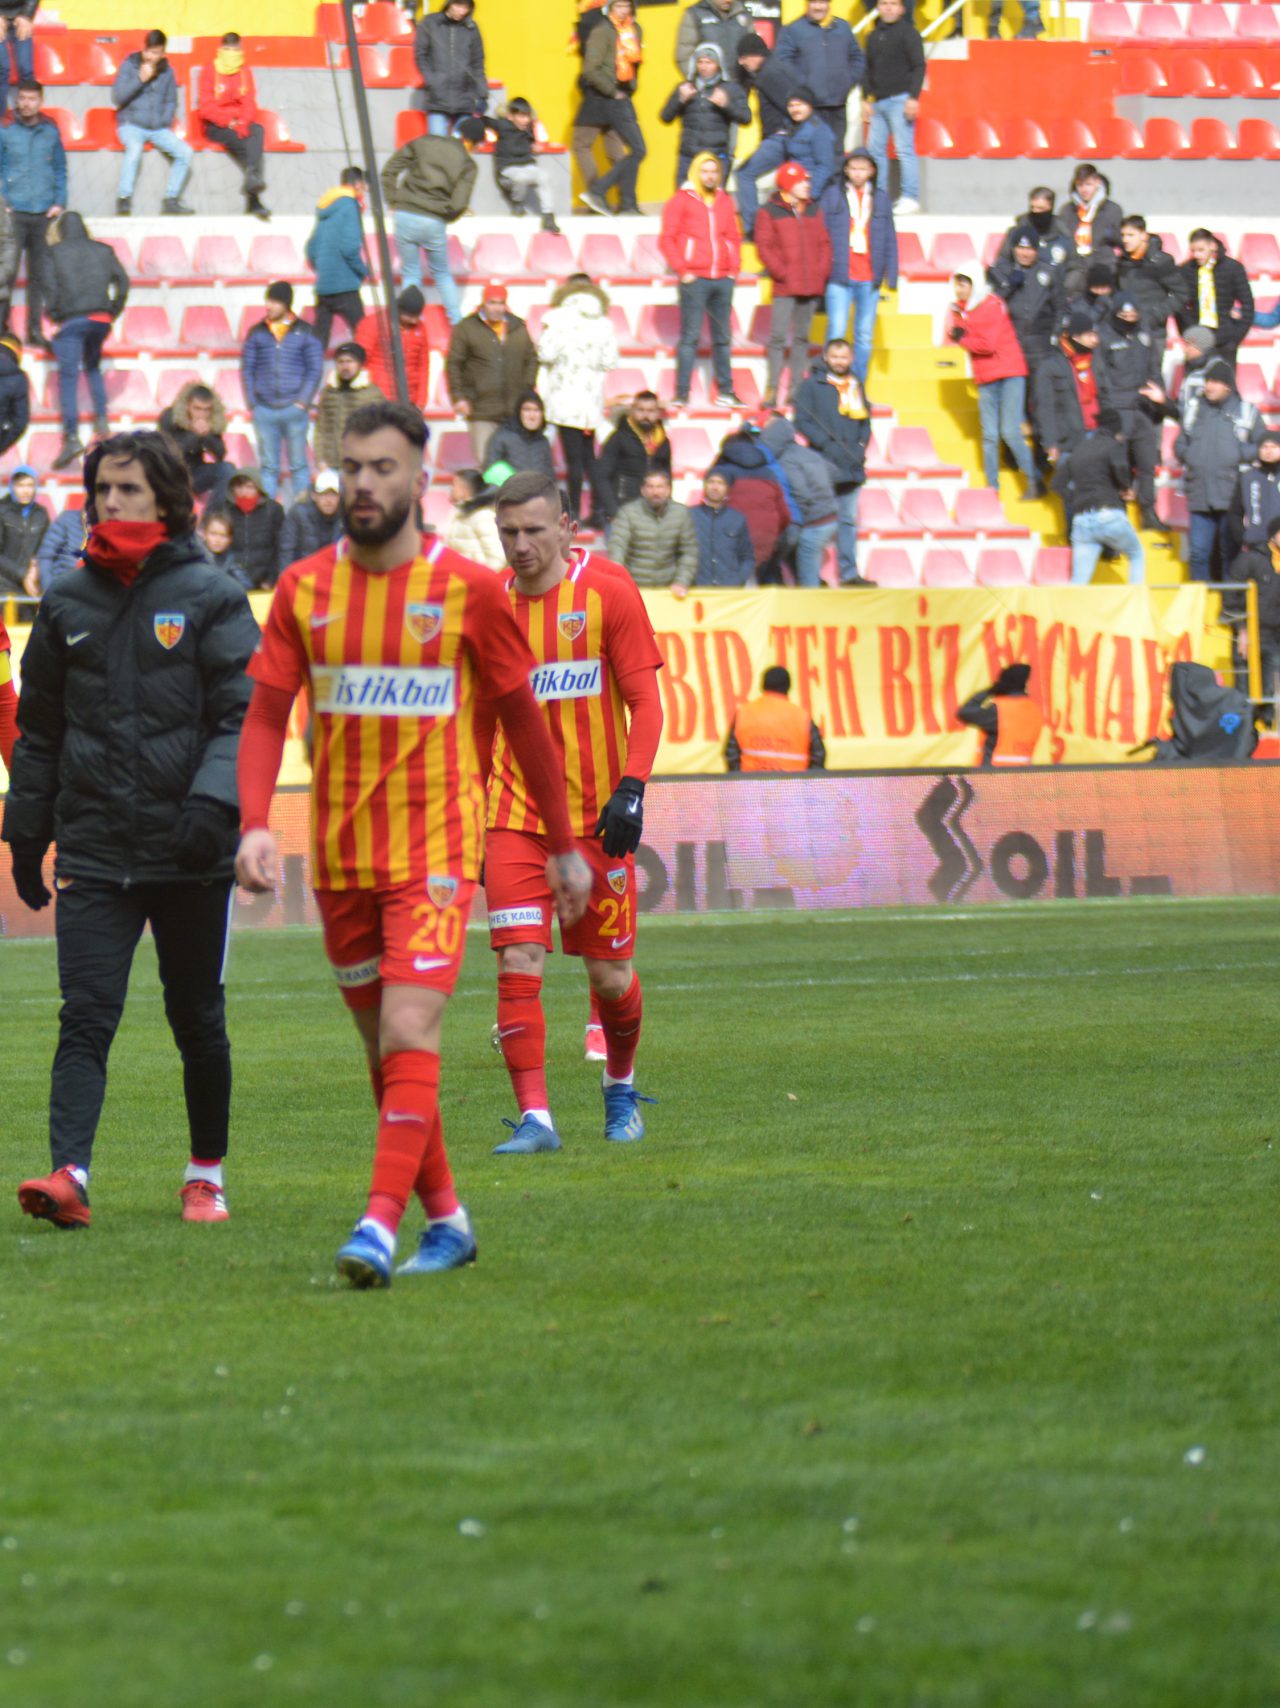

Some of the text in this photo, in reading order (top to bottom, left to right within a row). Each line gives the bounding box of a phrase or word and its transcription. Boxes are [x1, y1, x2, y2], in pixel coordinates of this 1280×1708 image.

[531, 666, 599, 695] tikbal
[878, 594, 965, 738] BİZ
[335, 675, 451, 706] istikbal
[407, 903, 462, 955] 20
[511, 911, 542, 921] KABLO
[599, 894, 630, 936] 21
